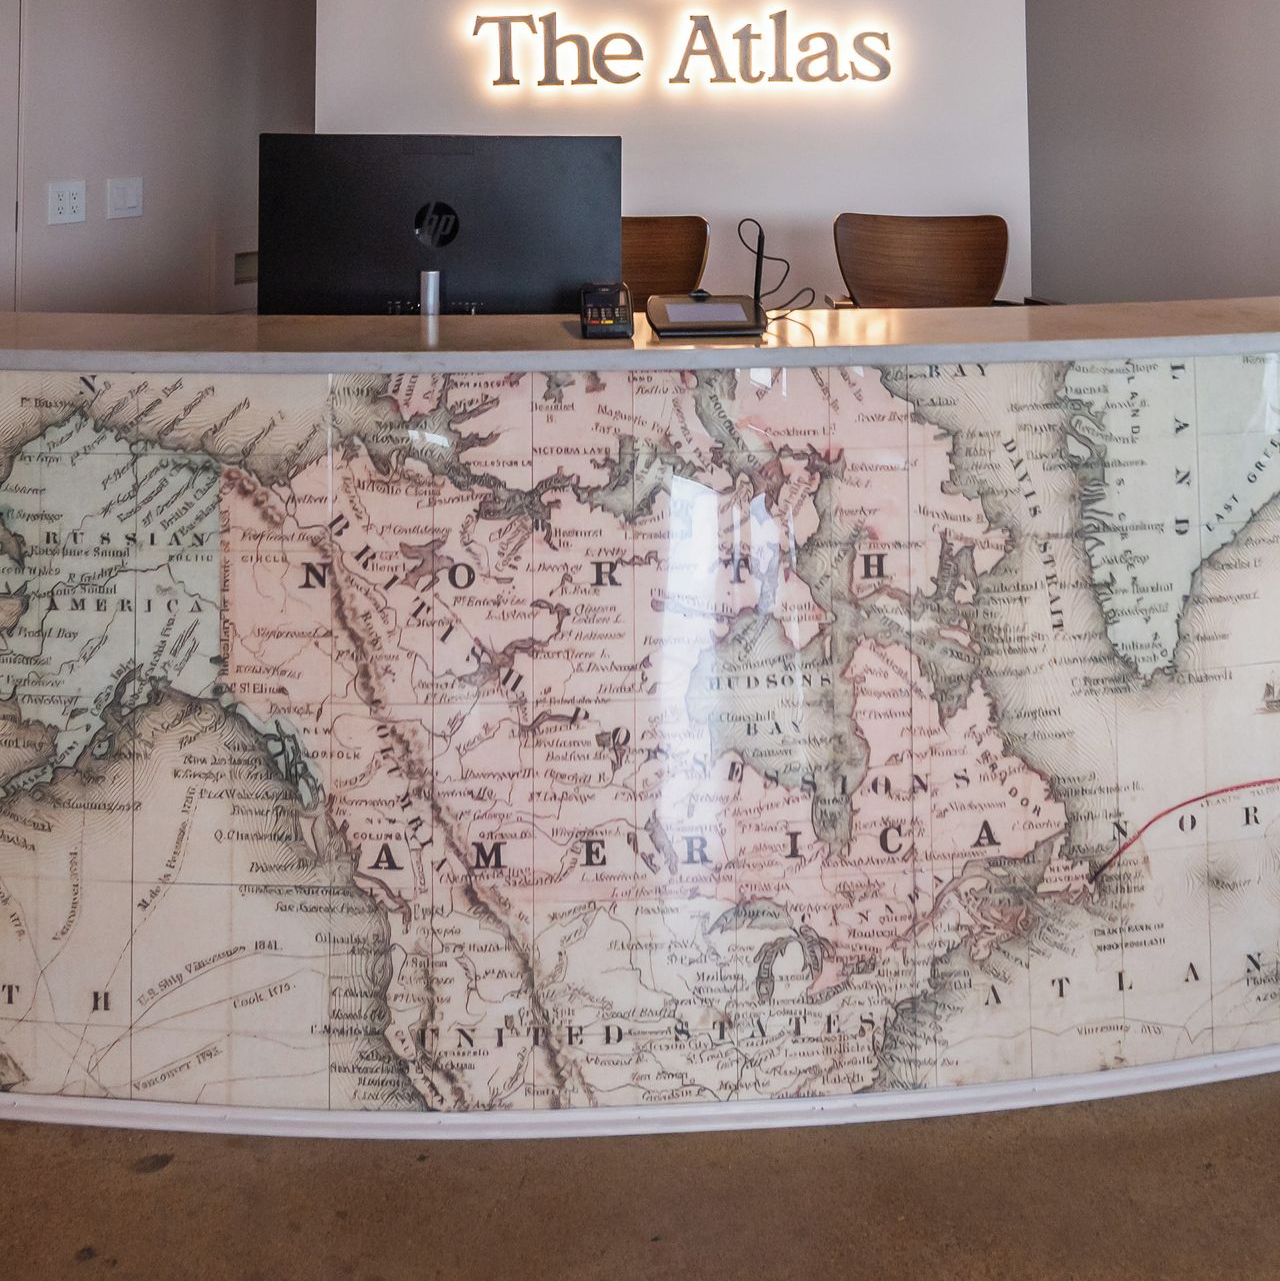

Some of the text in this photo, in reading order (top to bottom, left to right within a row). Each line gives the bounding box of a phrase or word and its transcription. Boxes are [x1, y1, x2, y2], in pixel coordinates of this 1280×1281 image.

[473, 9, 892, 86] The Atlas
[299, 553, 889, 590] NORTH
[46, 597, 203, 613] AMERICA
[709, 673, 832, 691] HUDSONS
[368, 819, 1002, 870] AMERICA
[419, 1024, 624, 1049] UNITED
